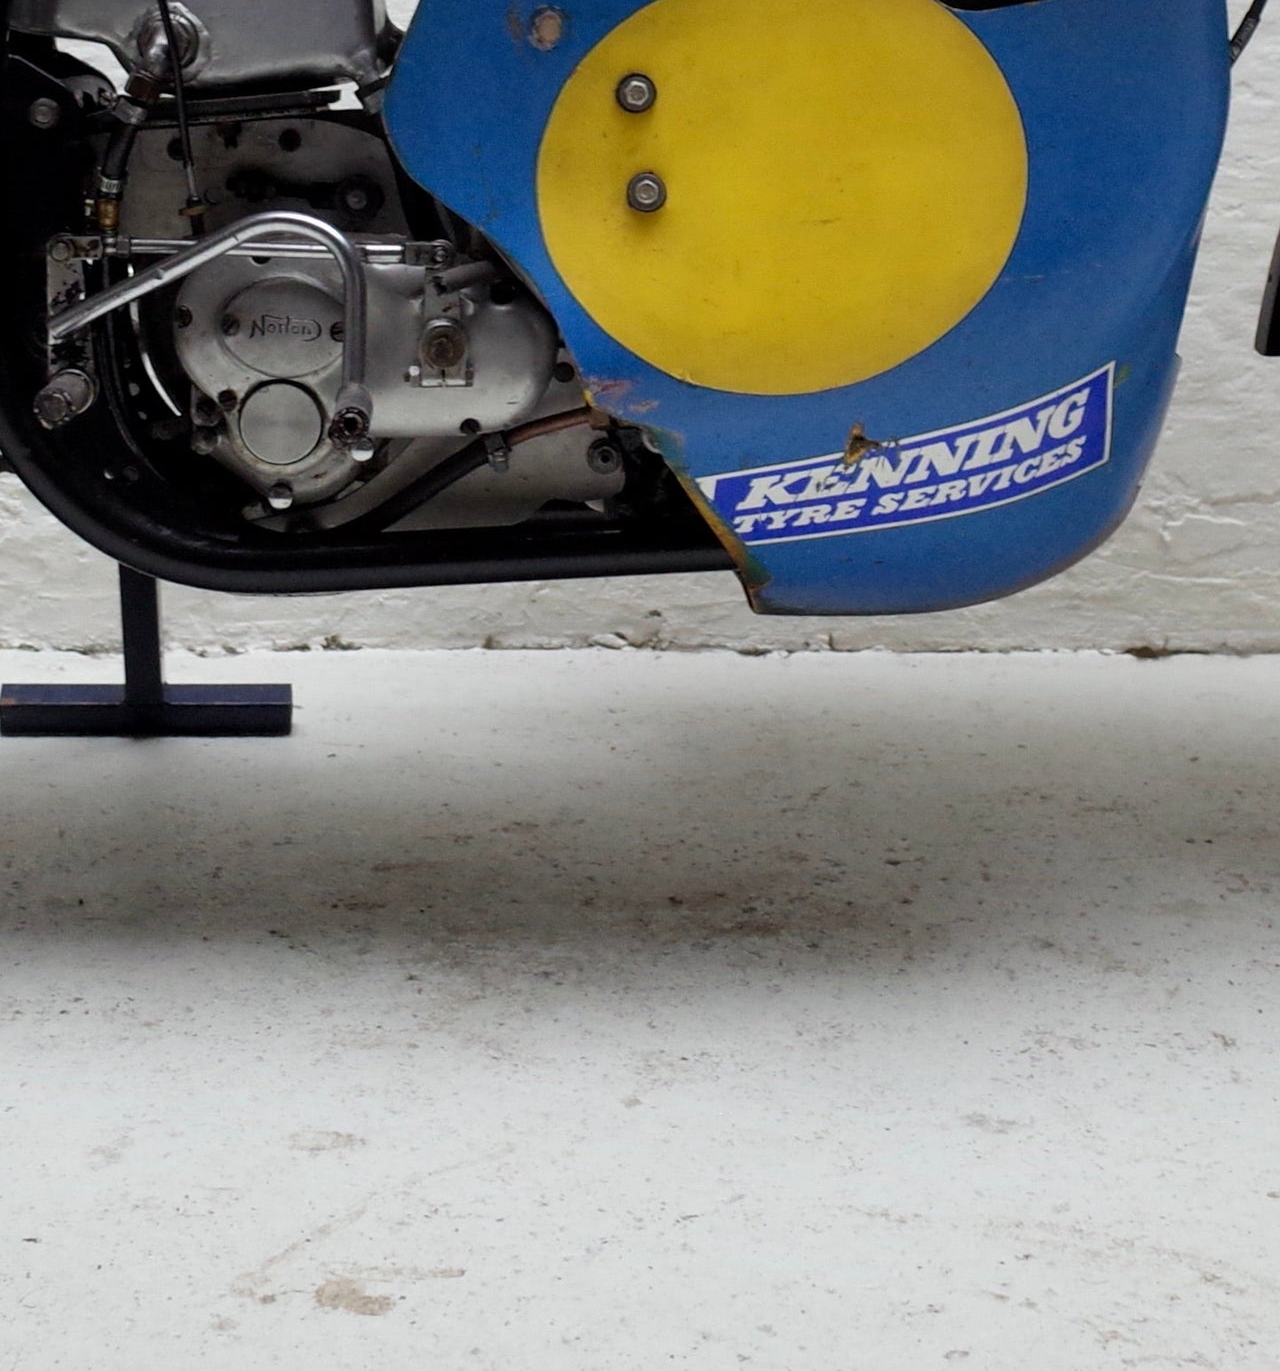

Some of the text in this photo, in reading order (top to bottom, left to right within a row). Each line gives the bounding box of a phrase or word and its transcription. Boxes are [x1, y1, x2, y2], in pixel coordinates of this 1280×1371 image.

[249, 314, 323, 342] Norton
[731, 435, 1087, 534] TYRE SERVICES
[735, 387, 1091, 512] KENNING
